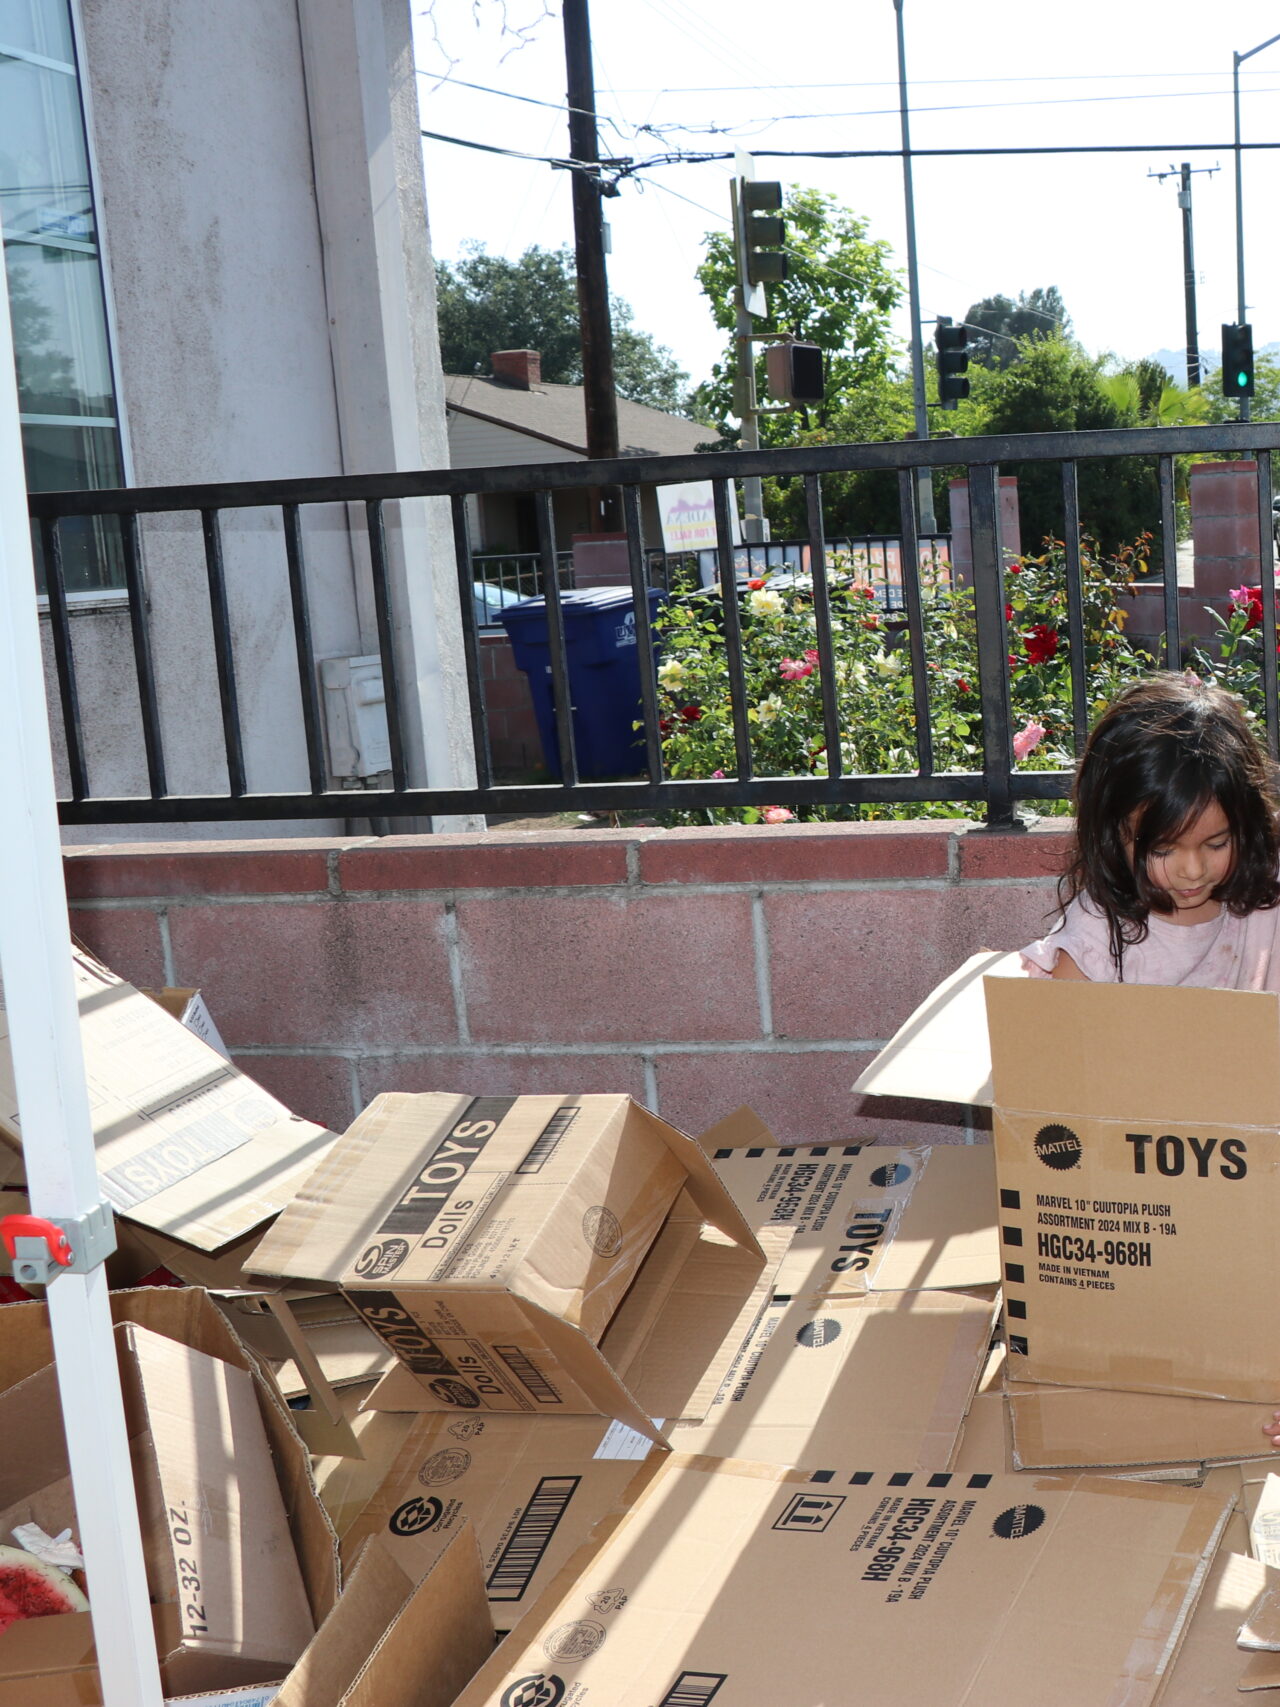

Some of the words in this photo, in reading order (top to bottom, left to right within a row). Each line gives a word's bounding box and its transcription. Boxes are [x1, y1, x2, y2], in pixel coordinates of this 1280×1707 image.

[1036, 1138, 1081, 1156] MATTEL
[1126, 1134, 1248, 1180] TOYS
[124, 1136, 215, 1193] TOYS
[401, 1119, 497, 1206] TOYS
[767, 1164, 783, 1183] CONTAINS
[782, 1164, 792, 1175] MADE
[835, 1164, 853, 1182] MARVEL
[814, 1164, 837, 1193] ASSORTMENT
[884, 1164, 898, 1187] MATTEL
[756, 1187, 769, 1202] PIECES
[768, 1180, 783, 1199] VIETNAM
[770, 1164, 819, 1220] HGC34-968H
[808, 1194, 822, 1206] 2024
[803, 1206, 816, 1216] MIX
[818, 1191, 839, 1215] CUUTOPIA
[1037, 1195, 1072, 1210] MARVEL
[1075, 1200, 1090, 1211] 10"
[1093, 1200, 1139, 1215] CUUTOPIA
[1142, 1204, 1171, 1217] PLUSH
[420, 1199, 474, 1249] Dolls
[811, 1215, 828, 1231] PLUSH
[1038, 1212, 1095, 1231] ASSORTMENT
[1098, 1219, 1120, 1232] 2024
[1123, 1222, 1140, 1233] MIX
[1144, 1222, 1150, 1234] B
[1160, 1223, 1176, 1236] 19A
[831, 1208, 893, 1273] TOYS
[1038, 1233, 1152, 1267] HGC34-968H
[372, 1244, 397, 1274] SPIN
[382, 1242, 407, 1275] MASTER
[1039, 1263, 1061, 1273] MADE
[1063, 1267, 1071, 1275] IN
[1073, 1268, 1109, 1279] VIETNAM
[1039, 1274, 1077, 1286] CONTAINS
[1078, 1279, 1086, 1289] 4
[1087, 1280, 1115, 1290] PIECES
[758, 1317, 780, 1338] MARVEL
[812, 1320, 825, 1348] MATTEL
[362, 1307, 455, 1375] TOYS
[457, 1356, 504, 1394] Dolls
[741, 1351, 763, 1380] CUUTOPIA
[730, 1380, 749, 1402] PLUSH
[461, 1424, 470, 1434] 20
[474, 1422, 485, 1436] PAP
[432, 1498, 457, 1533] Corrugated
[444, 1501, 464, 1530] Recycles
[869, 1497, 891, 1524] CONTAINS
[889, 1497, 904, 1514] MADE
[953, 1500, 977, 1527] MARVEL
[169, 1501, 192, 1546] OZ.
[921, 1500, 956, 1543] ASSORTMENT
[1010, 1506, 1027, 1539] MATTEL
[850, 1531, 869, 1552] PIECES
[861, 1498, 936, 1582] HGC34-968H
[869, 1520, 887, 1549] VIETNAM
[948, 1527, 960, 1541] 10"
[909, 1541, 931, 1561] 2024
[921, 1540, 952, 1576] CUUTOPIA
[902, 1561, 920, 1576] MIX
[177, 1557, 208, 1637] 12-32
[885, 1588, 904, 1603] 19A
[908, 1573, 932, 1600] PLUSH
[600, 1596, 611, 1605] 20
[615, 1596, 628, 1610] PAP
